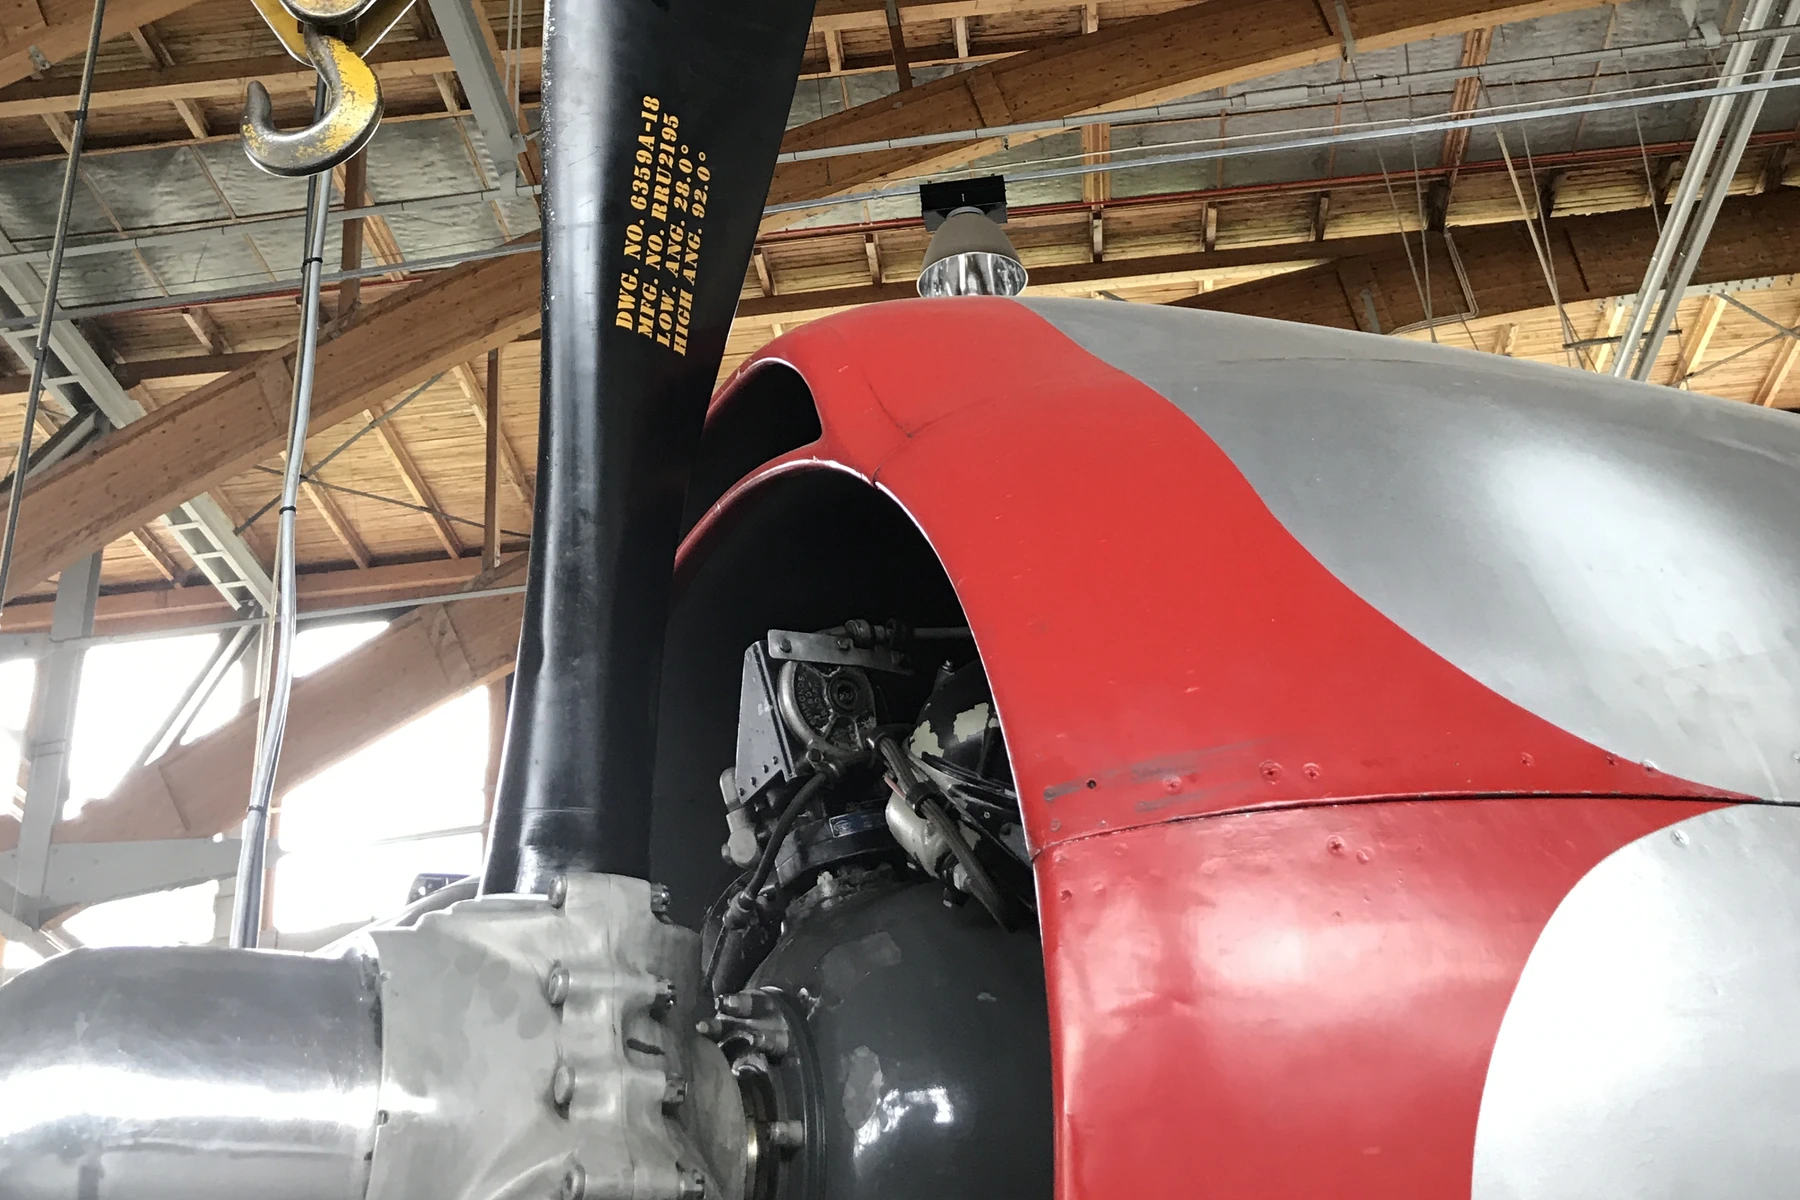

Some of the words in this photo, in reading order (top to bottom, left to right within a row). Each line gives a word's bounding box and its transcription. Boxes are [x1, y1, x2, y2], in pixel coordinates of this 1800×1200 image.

[630, 95, 660, 211] 6359A-18
[651, 112, 679, 222] RRU2195
[673, 144, 693, 213] 28.0°
[691, 151, 711, 219] 92.0°
[624, 219, 645, 261] NO.
[645, 229, 665, 271] NO.
[665, 220, 686, 279] ANG.
[682, 228, 703, 287] ANG.
[615, 268, 640, 331] DWG.
[637, 278, 659, 339] MFG.
[656, 286, 677, 347] LOW.
[673, 288, 693, 357] HIGH
